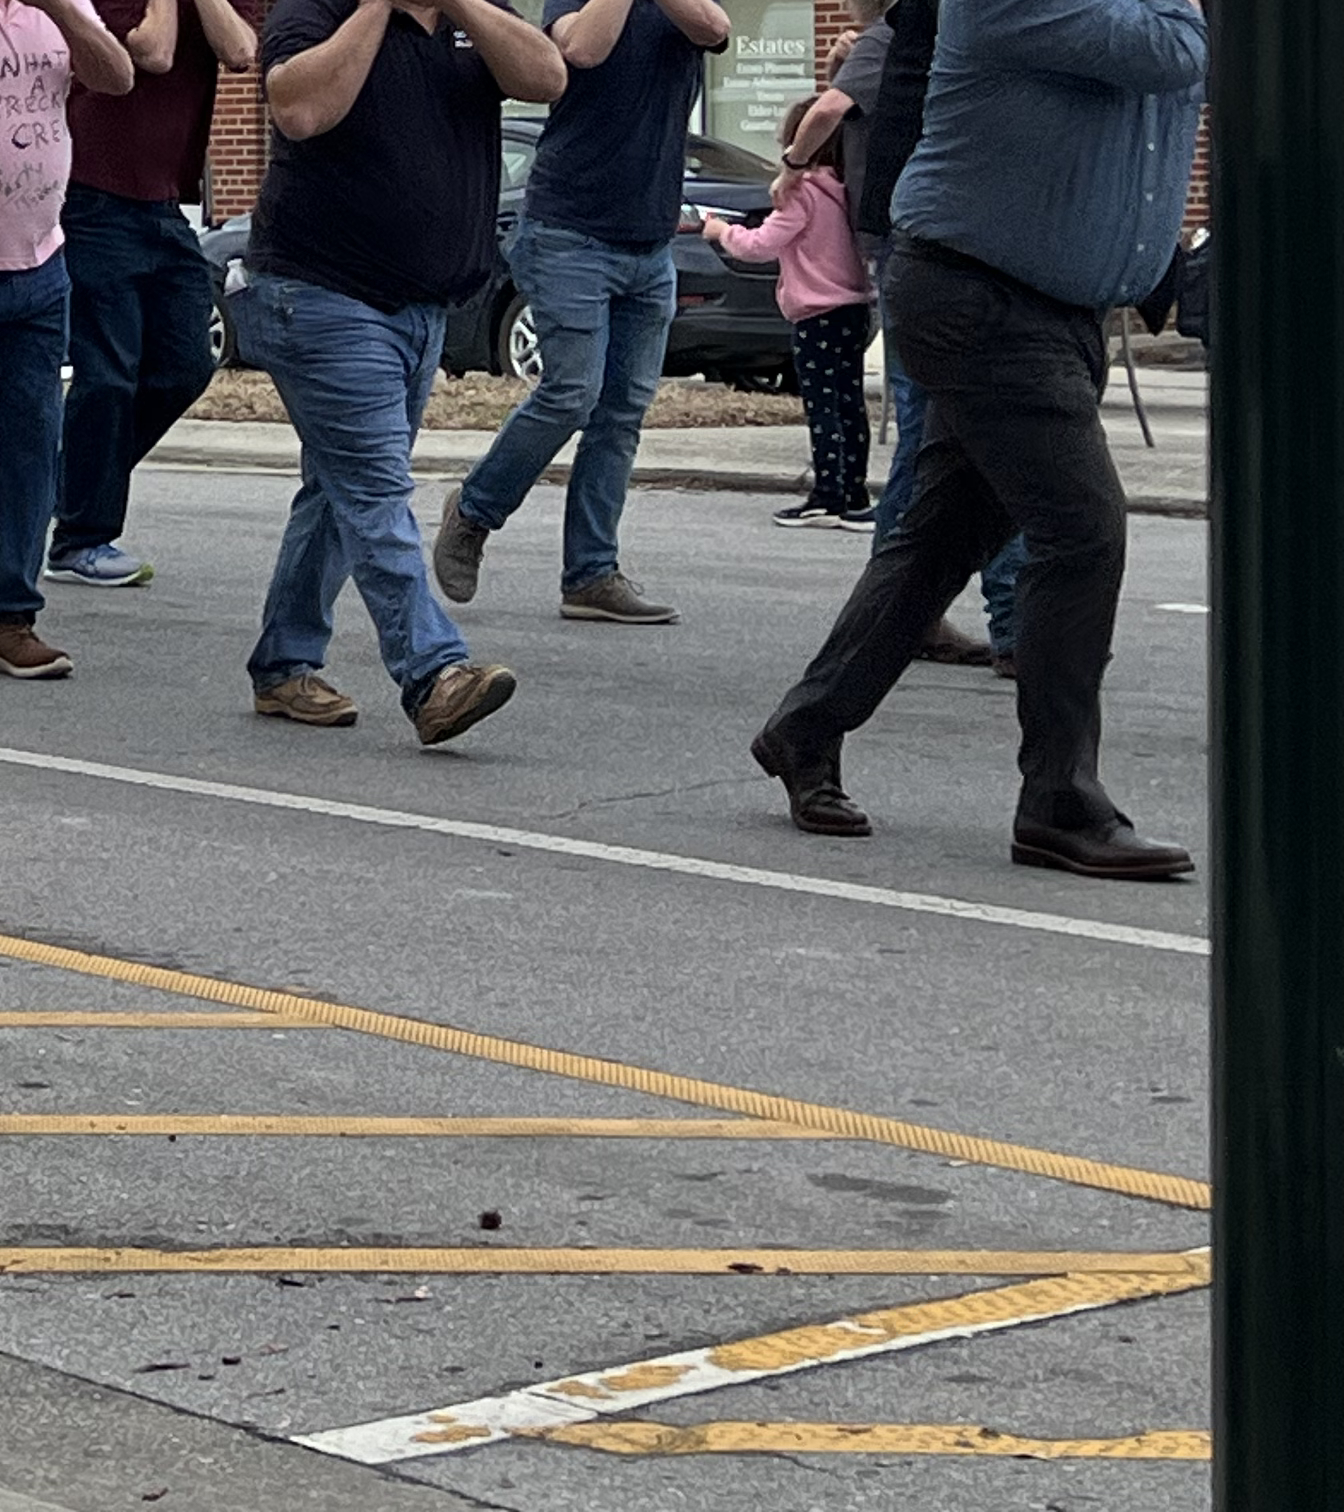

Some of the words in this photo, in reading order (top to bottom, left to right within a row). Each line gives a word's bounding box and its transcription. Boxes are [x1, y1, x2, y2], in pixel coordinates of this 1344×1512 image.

[736, 35, 806, 55] Estates
[30, 75, 45, 95] A
[10, 119, 68, 150] CRE
